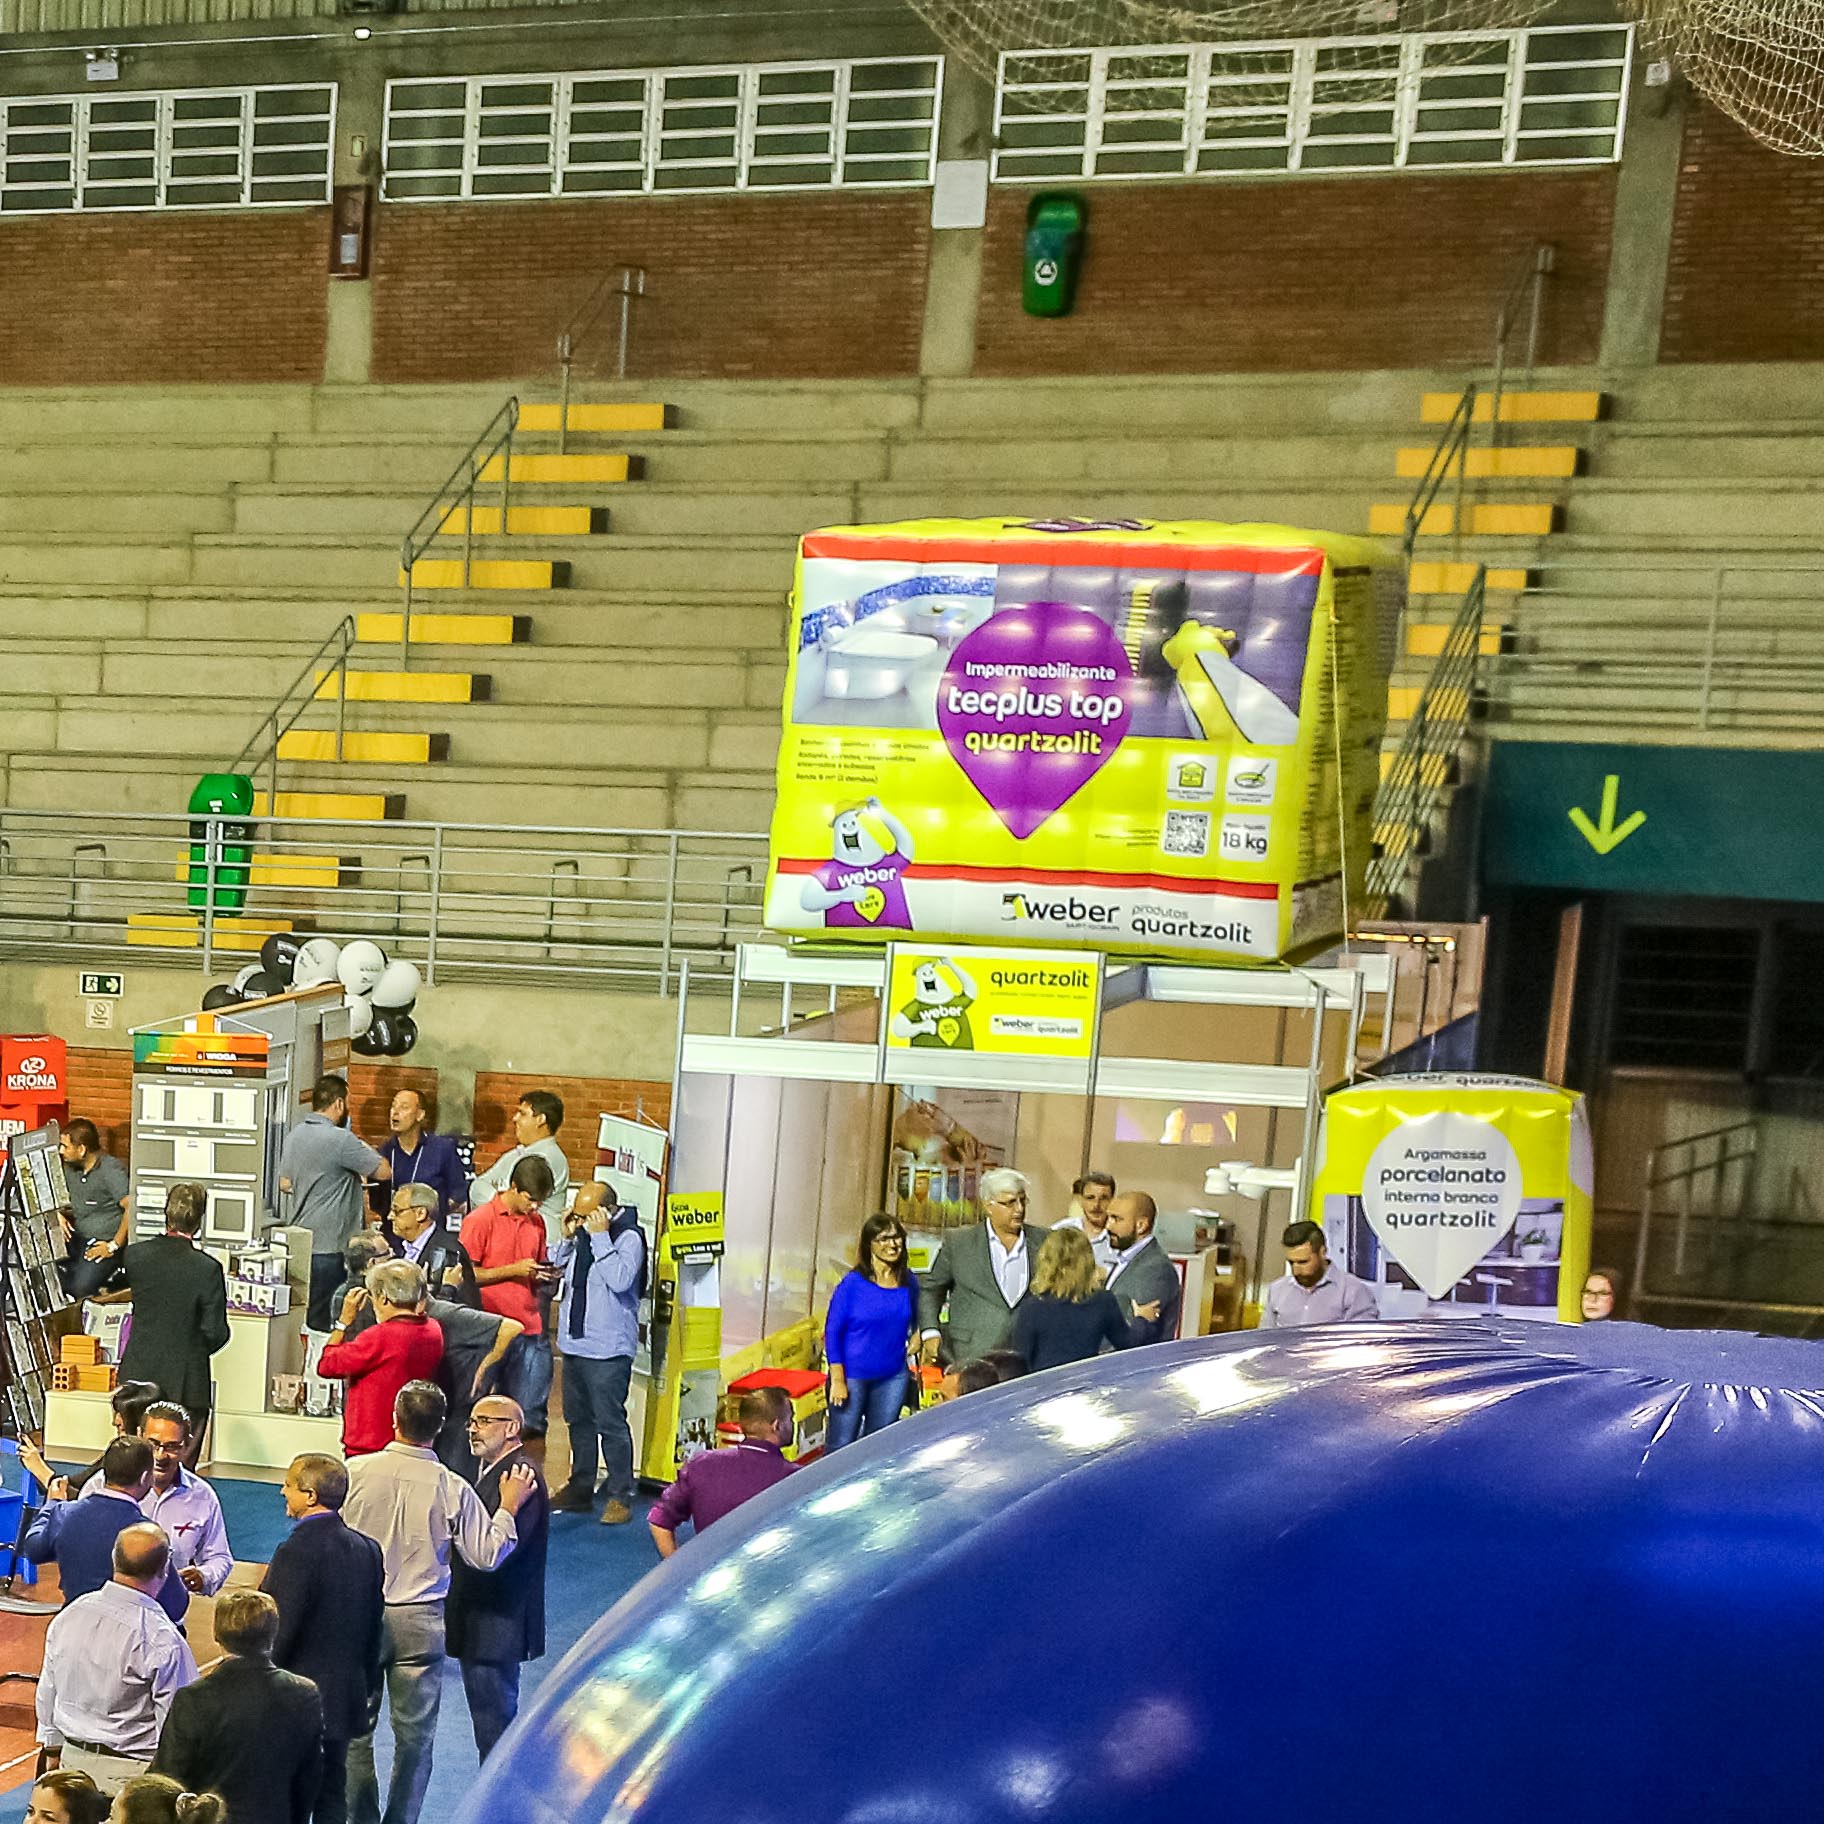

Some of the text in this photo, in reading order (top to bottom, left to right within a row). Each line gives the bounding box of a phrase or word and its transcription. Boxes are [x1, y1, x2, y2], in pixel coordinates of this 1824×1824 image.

[966, 661, 1117, 682] Impermeabilizante
[947, 686, 1124, 725] tecplus top
[965, 730, 1102, 755] quartzolit
[1223, 832, 1267, 854] 18 kg
[838, 866, 896, 888] weber
[1025, 897, 1120, 923] weber
[1132, 905, 1189, 919] produtos
[1131, 917, 1252, 944] quartzolit
[990, 969, 1090, 988] quartzolit
[919, 1005, 962, 1021] weber
[1003, 1018, 1034, 1028] weber
[8, 1074, 56, 1086] KRONA
[1404, 1148, 1487, 1162] Argamassa
[1381, 1166, 1506, 1185] porcelanato
[1385, 1189, 1498, 1205] interno branco
[673, 1209, 719, 1226] weber
[1386, 1210, 1496, 1229] quartzolit
